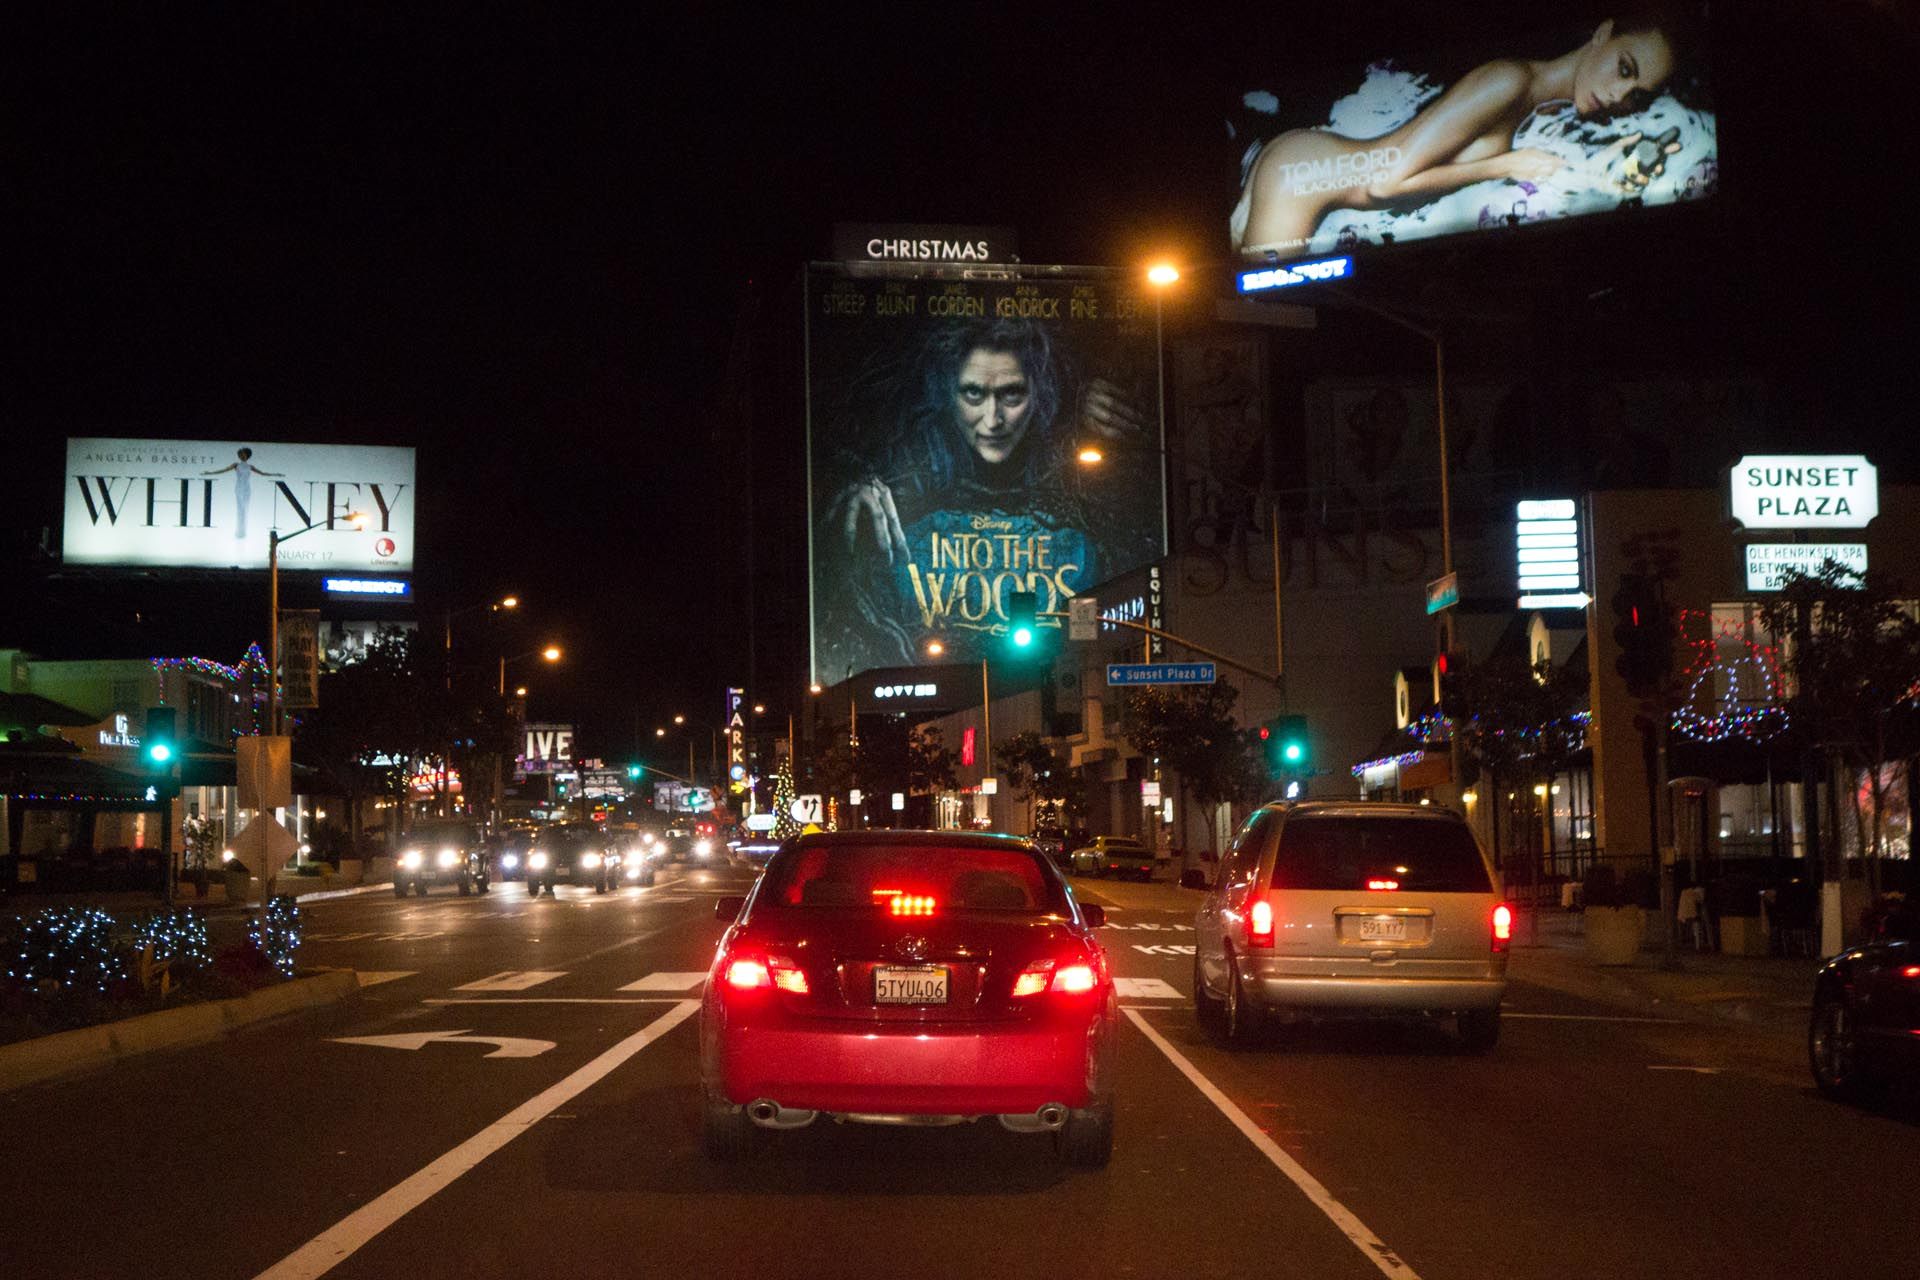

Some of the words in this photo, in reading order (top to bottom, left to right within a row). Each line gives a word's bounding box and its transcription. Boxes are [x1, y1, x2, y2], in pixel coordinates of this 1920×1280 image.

[1279, 159, 1334, 186] TOM
[1335, 147, 1402, 176] FORD
[1294, 177, 1341, 196] BLACK
[1339, 170, 1390, 189] ORCHID
[866, 238, 990, 261] CHRISTMAS
[822, 293, 867, 316] STREEP
[875, 294, 916, 316] BLUNT
[927, 295, 985, 317] CORDEN
[995, 296, 1061, 319] KENDRICK
[1069, 298, 1099, 320] PINE
[85, 453, 143, 463] ANGELA
[151, 454, 215, 465] BASSETT
[1747, 467, 1859, 487] SUNSET
[1757, 496, 1853, 516] PLAZA
[969, 514, 1013, 534] Disney
[321, 551, 334, 561] 17
[930, 532, 993, 570] INTO
[993, 534, 1053, 570] THE
[1748, 548, 1771, 559] OLE
[1774, 547, 1839, 559] HENRIKSEN
[1842, 547, 1863, 559] SPA
[907, 563, 1079, 630] WOODS
[1126, 668, 1163, 680] Sunset
[1167, 667, 1197, 680] Plaza
[1200, 667, 1213, 679] Dr
[729, 695, 745, 763] PARK
[878, 979, 944, 998] 5TYU406
